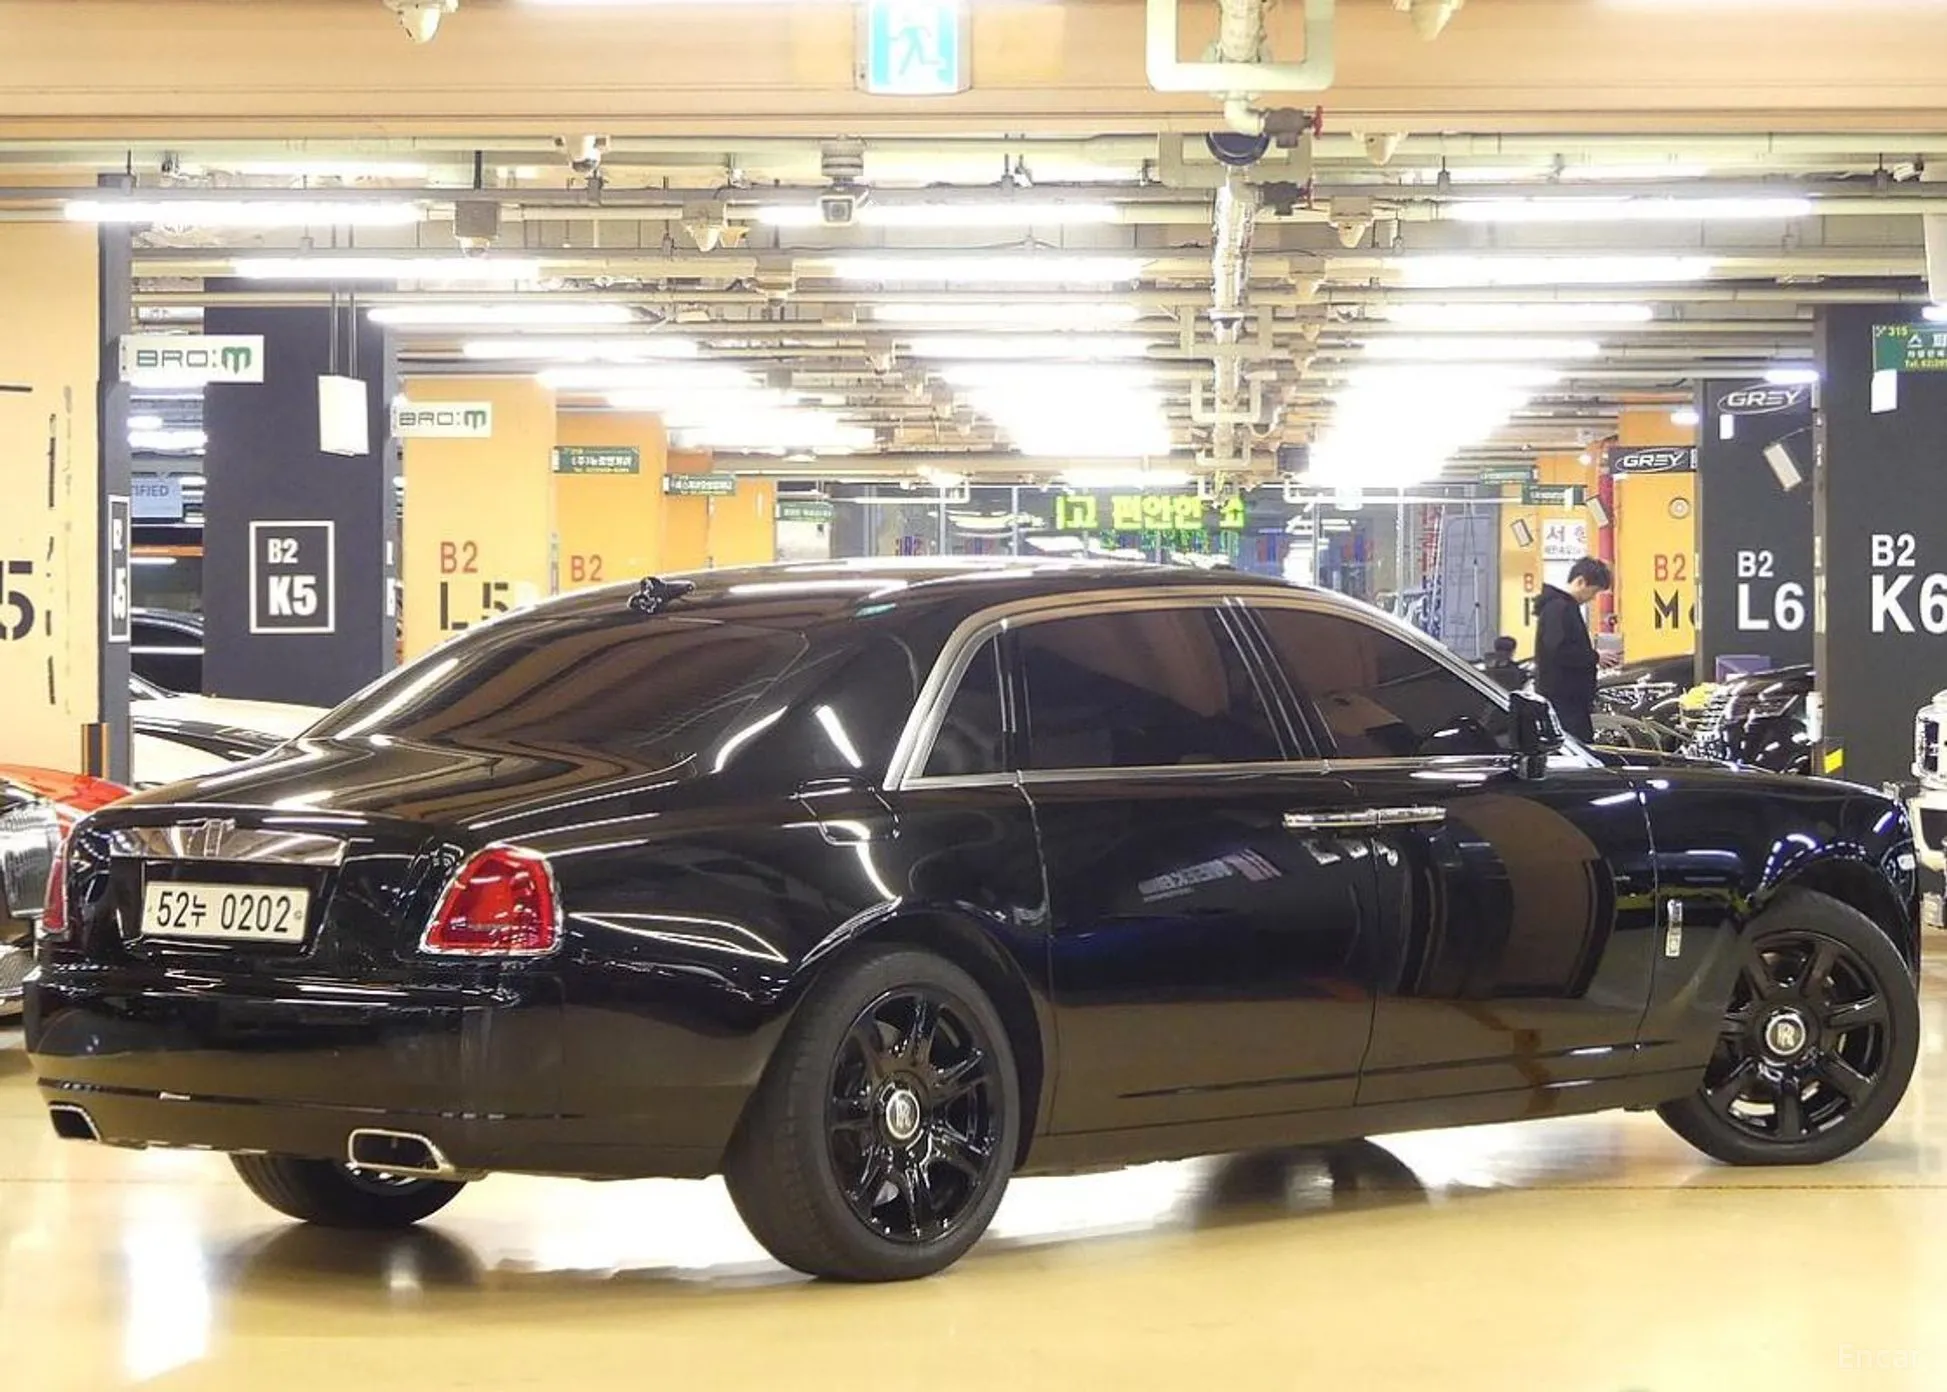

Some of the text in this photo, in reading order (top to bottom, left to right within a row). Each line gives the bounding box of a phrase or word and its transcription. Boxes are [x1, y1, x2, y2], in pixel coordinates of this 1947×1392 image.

[1726, 390, 1801, 407] GREY
[1623, 454, 1684, 468] GREY
[132, 484, 169, 497] IFIED
[268, 538, 299, 563] B2
[440, 541, 478, 574] B2
[1738, 550, 1774, 578] B2
[1871, 533, 1916, 567] B2
[571, 555, 603, 582] B2
[1654, 553, 1686, 581] B2
[268, 575, 318, 616] K5
[1738, 582, 1805, 631] L6
[1871, 572, 1947, 635] K6
[156, 890, 292, 933] 52누 0202
